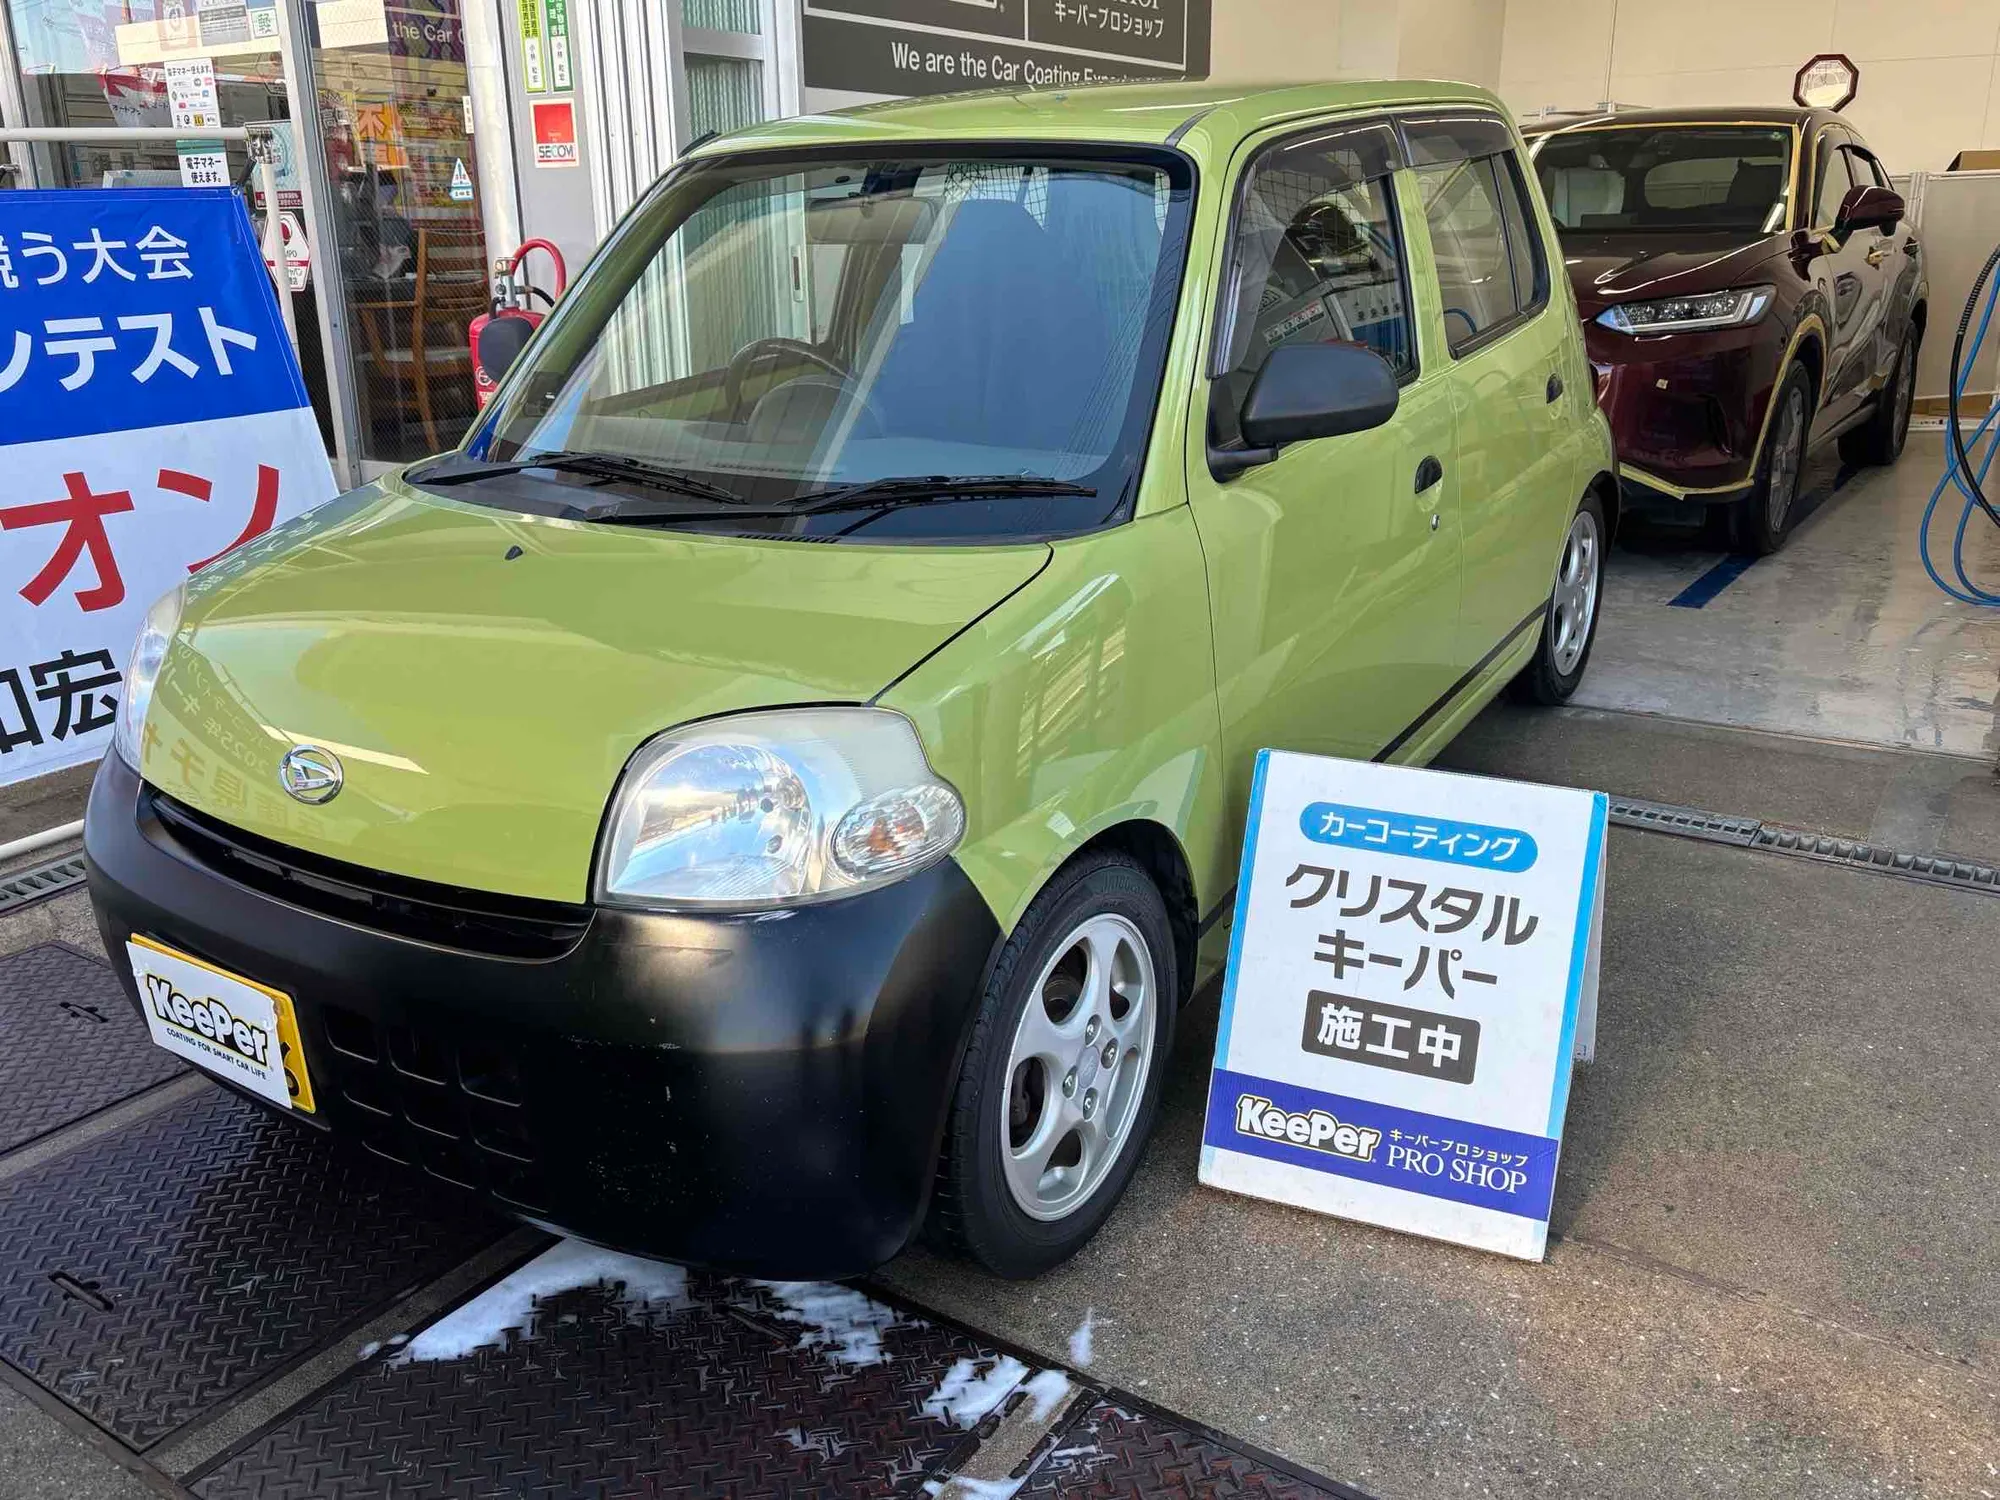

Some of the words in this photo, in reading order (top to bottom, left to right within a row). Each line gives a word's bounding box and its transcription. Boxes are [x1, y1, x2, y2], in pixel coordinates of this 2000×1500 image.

[392, 20, 420, 40] the
[424, 24, 452, 43] Car
[1055, 0, 1164, 38] キーパープロショップ
[891, 41, 920, 71] We
[925, 51, 955, 75] are
[959, 51, 987, 78] the
[991, 55, 1020, 82] Car
[186, 157, 222, 170] 電子マネー
[538, 145, 574, 159] SECOM
[1319, 811, 1521, 862] カーコーティング
[1285, 863, 1539, 946] クリスタル
[1313, 928, 1498, 1000] キーパー
[147, 974, 268, 1067] KeePer
[1316, 1002, 1462, 1068] 施工中
[166, 1027, 197, 1047] COATING
[197, 1041, 211, 1054] FOR
[213, 1048, 235, 1065] SMART
[236, 1058, 250, 1072] CAR
[251, 1066, 267, 1081] LIFE
[1235, 1093, 1381, 1163] KeePer
[1389, 1128, 1528, 1167] キーパープロショップ
[1386, 1143, 1445, 1178] PRO
[1449, 1159, 1527, 1195] SHOP
